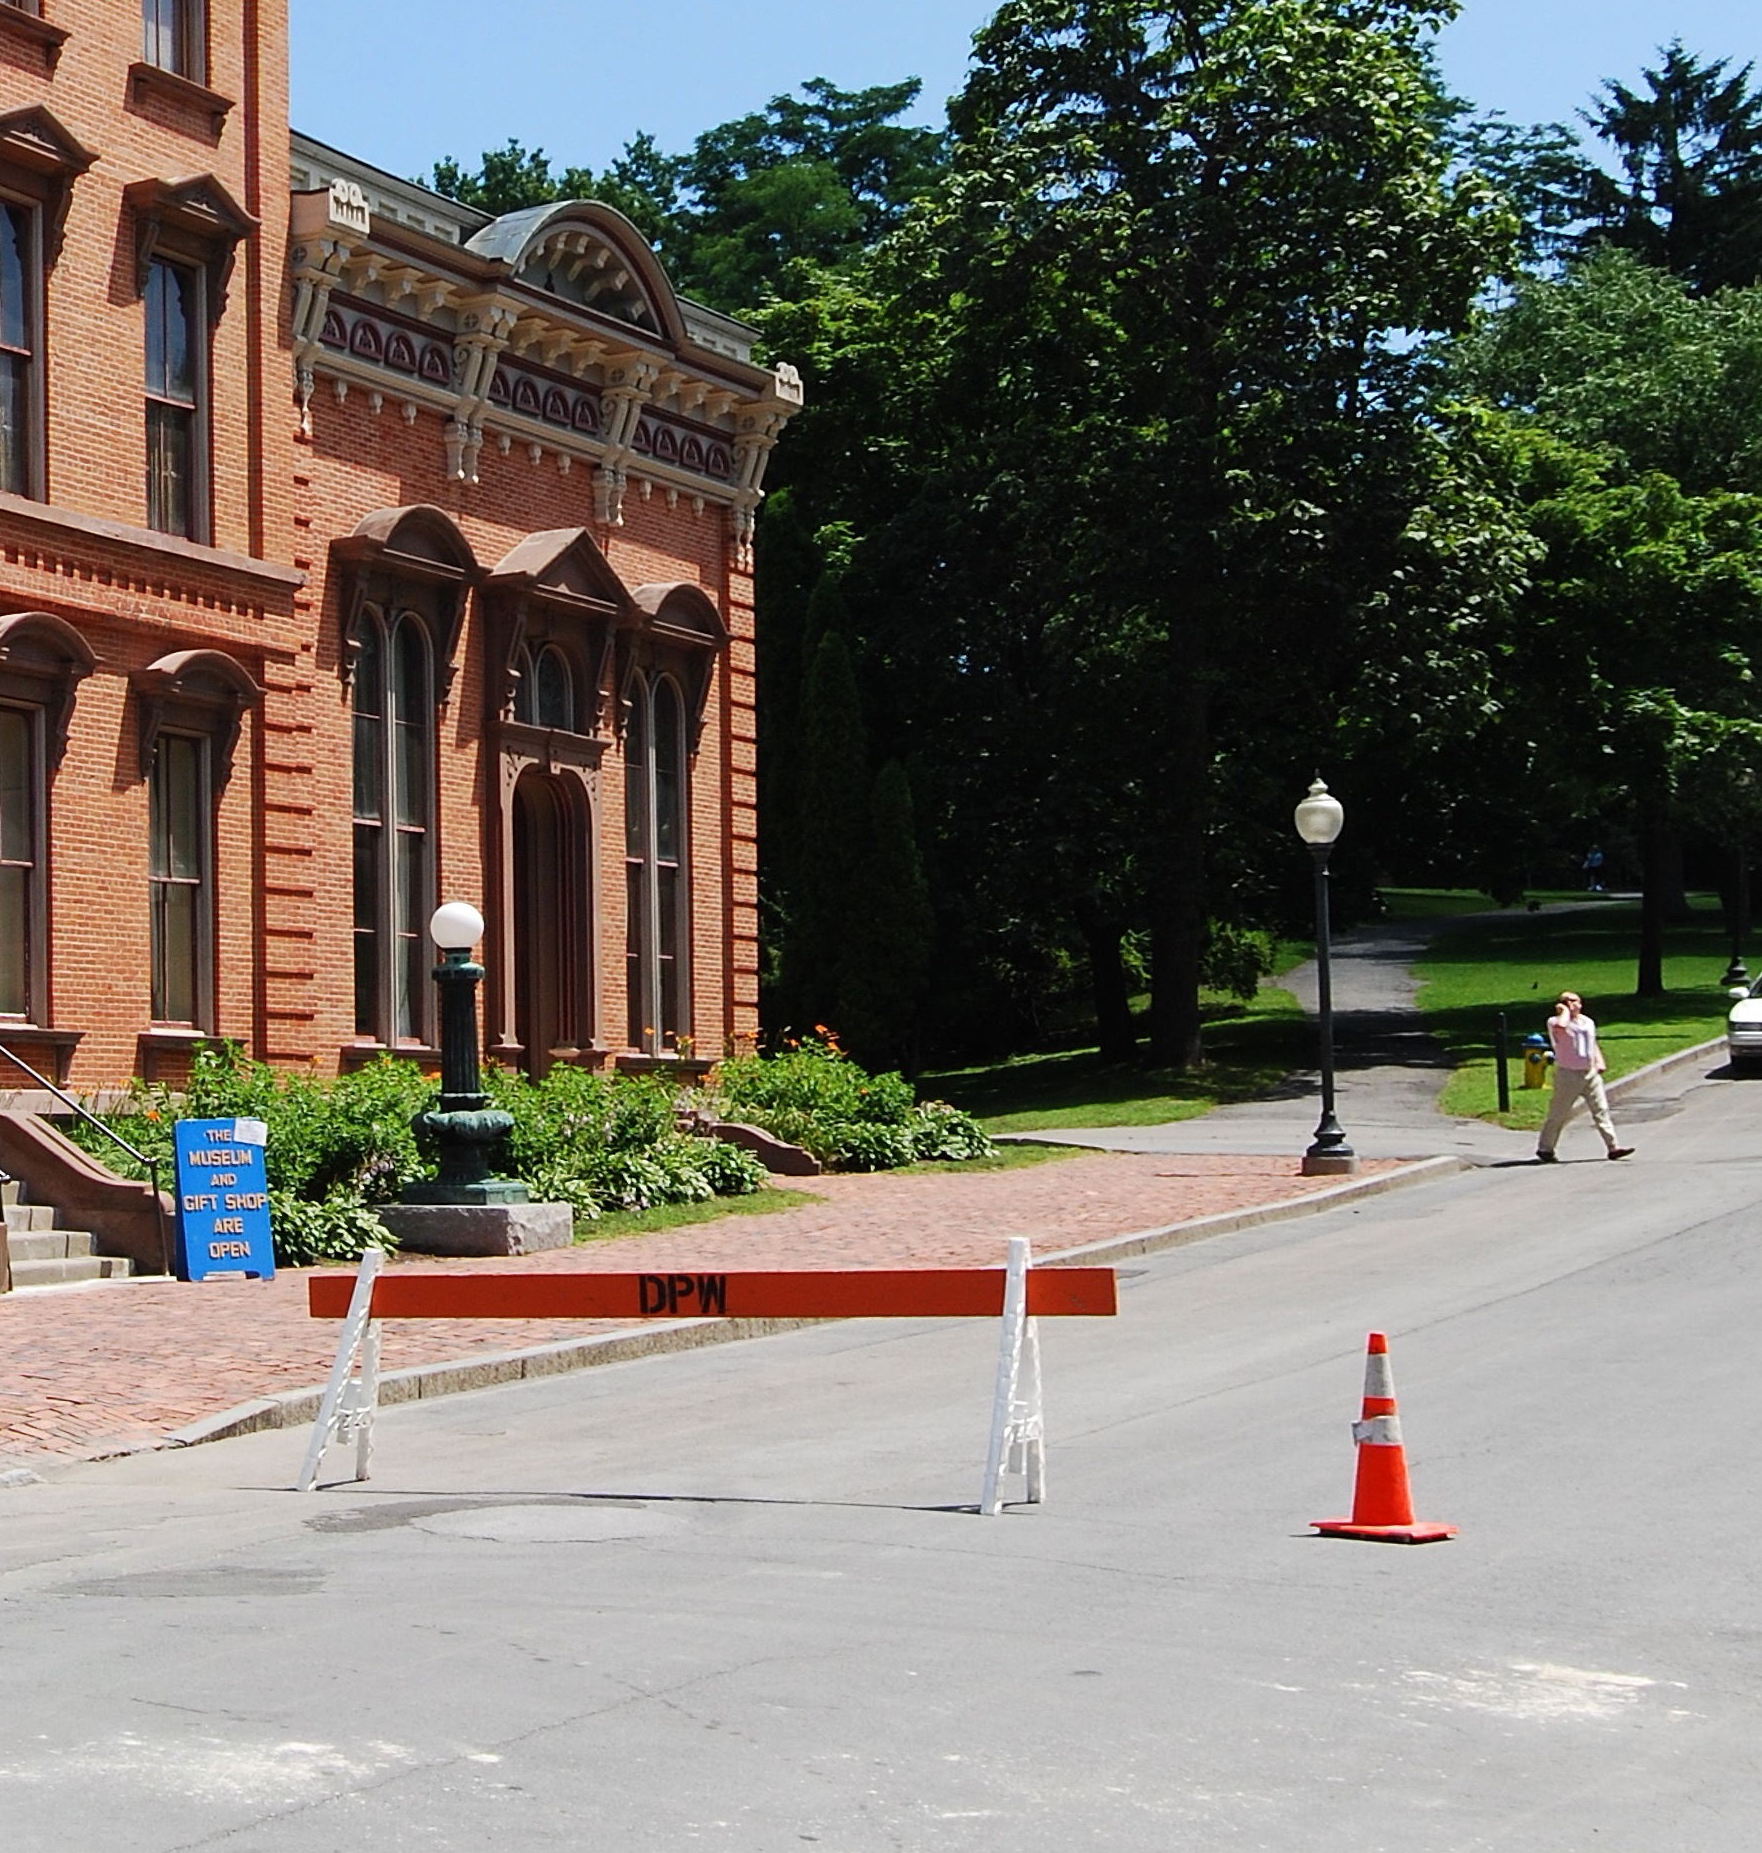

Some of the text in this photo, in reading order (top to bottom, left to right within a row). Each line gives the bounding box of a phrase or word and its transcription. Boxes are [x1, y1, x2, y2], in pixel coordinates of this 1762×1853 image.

[206, 1129, 233, 1143] THE
[188, 1149, 253, 1166] MUSEUM
[210, 1173, 238, 1187] AND
[182, 1193, 268, 1211] GIFT SHOP
[213, 1217, 245, 1234] ARE
[208, 1241, 252, 1259] OPEN
[639, 1275, 727, 1315] DPW
